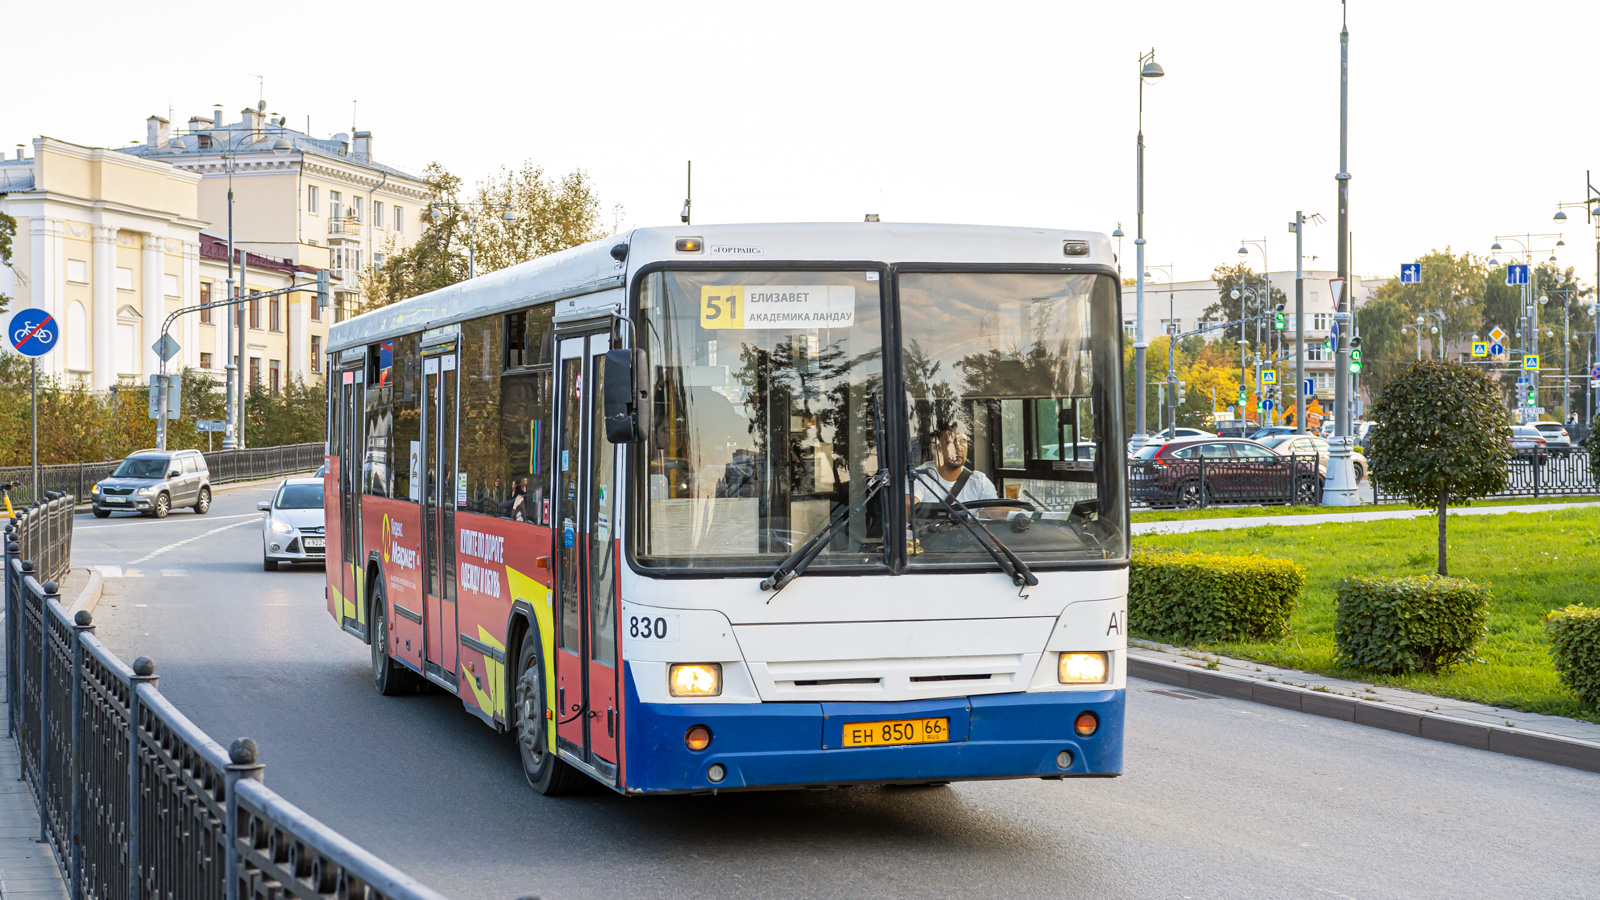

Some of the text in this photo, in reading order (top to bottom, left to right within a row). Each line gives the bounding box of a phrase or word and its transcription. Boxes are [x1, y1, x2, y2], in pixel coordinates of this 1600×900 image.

[713, 246, 761, 255] «ГОРТРАНС»
[705, 295, 737, 320] 51
[750, 292, 810, 303] ЕЛИЗАВЕТ
[749, 311, 853, 323] АКАДЕМИКА ЛАНДАУ
[391, 540, 416, 570] Маркет
[630, 615, 668, 639] 830
[852, 720, 942, 744] ЕН 850 66
